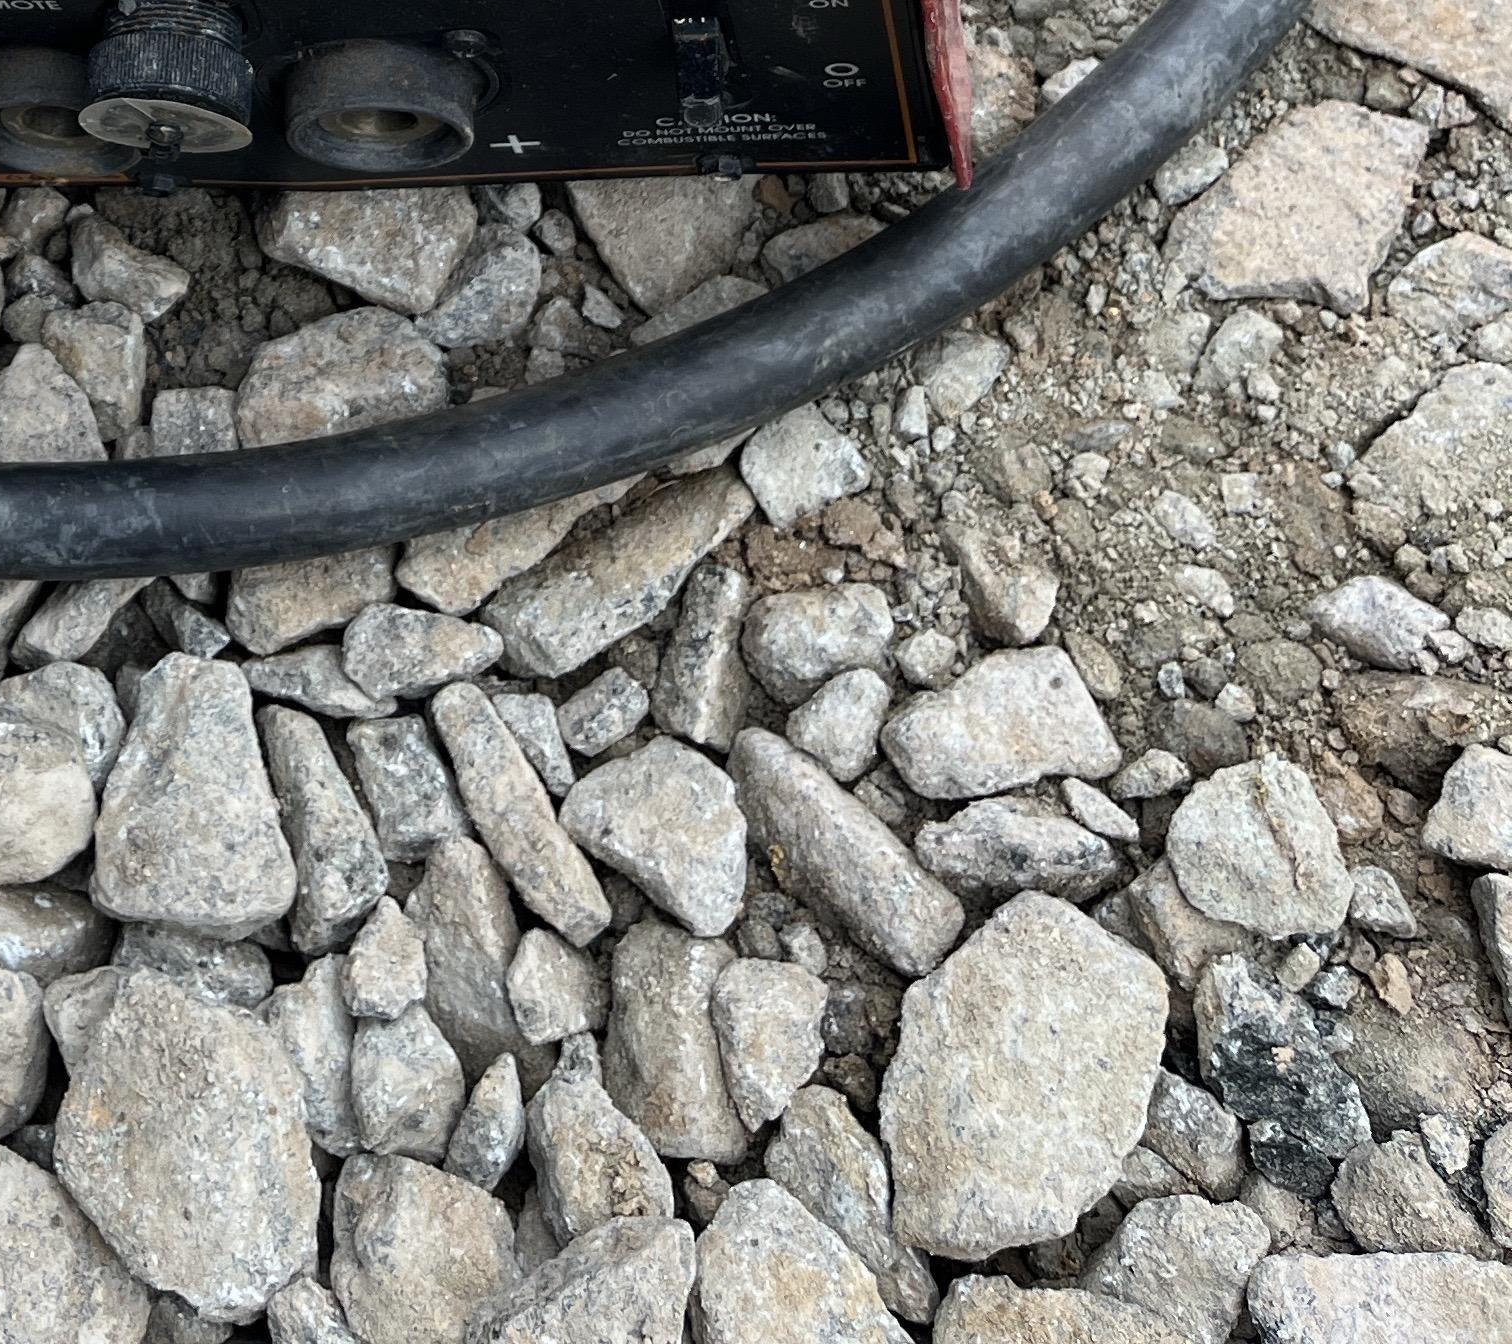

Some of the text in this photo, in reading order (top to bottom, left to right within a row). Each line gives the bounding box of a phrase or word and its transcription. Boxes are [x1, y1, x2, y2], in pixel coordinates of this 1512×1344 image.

[821, 77, 868, 89] OFF
[616, 130, 828, 147] COMBUSTIBLE SURFACES
[621, 122, 817, 139] DO NOT MOUNT OVER
